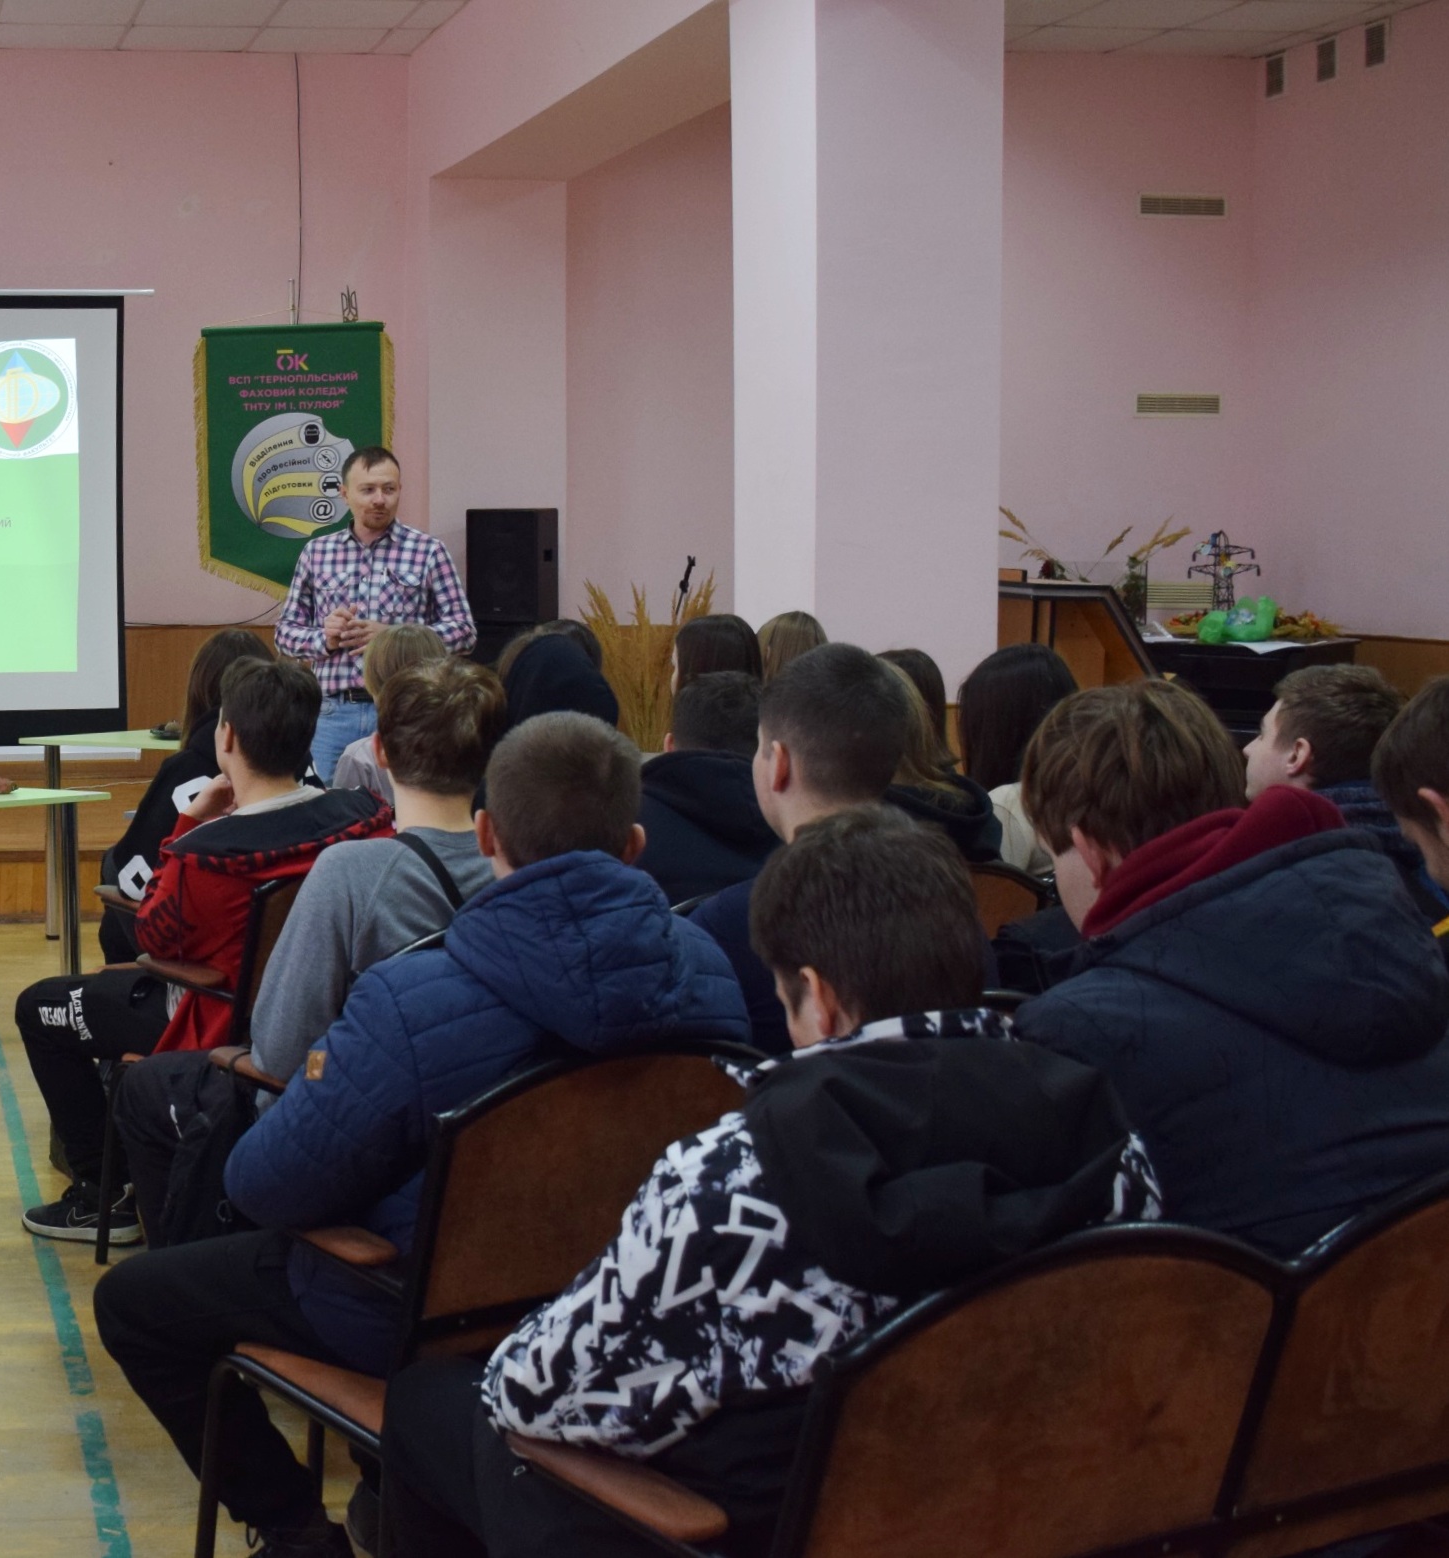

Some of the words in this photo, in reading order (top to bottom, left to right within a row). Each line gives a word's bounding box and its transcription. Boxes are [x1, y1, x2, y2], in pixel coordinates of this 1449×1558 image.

[229, 376, 251, 385] ВСП
[239, 386, 296, 398] ФАХОВИЙ
[298, 386, 348, 398] КОЛЕДЖ
[243, 402, 271, 411] ТНТУ
[275, 402, 286, 410] ІМ
[250, 438, 294, 468] Відділення
[257, 458, 311, 483] професійної
[264, 481, 313, 498] підготовки
